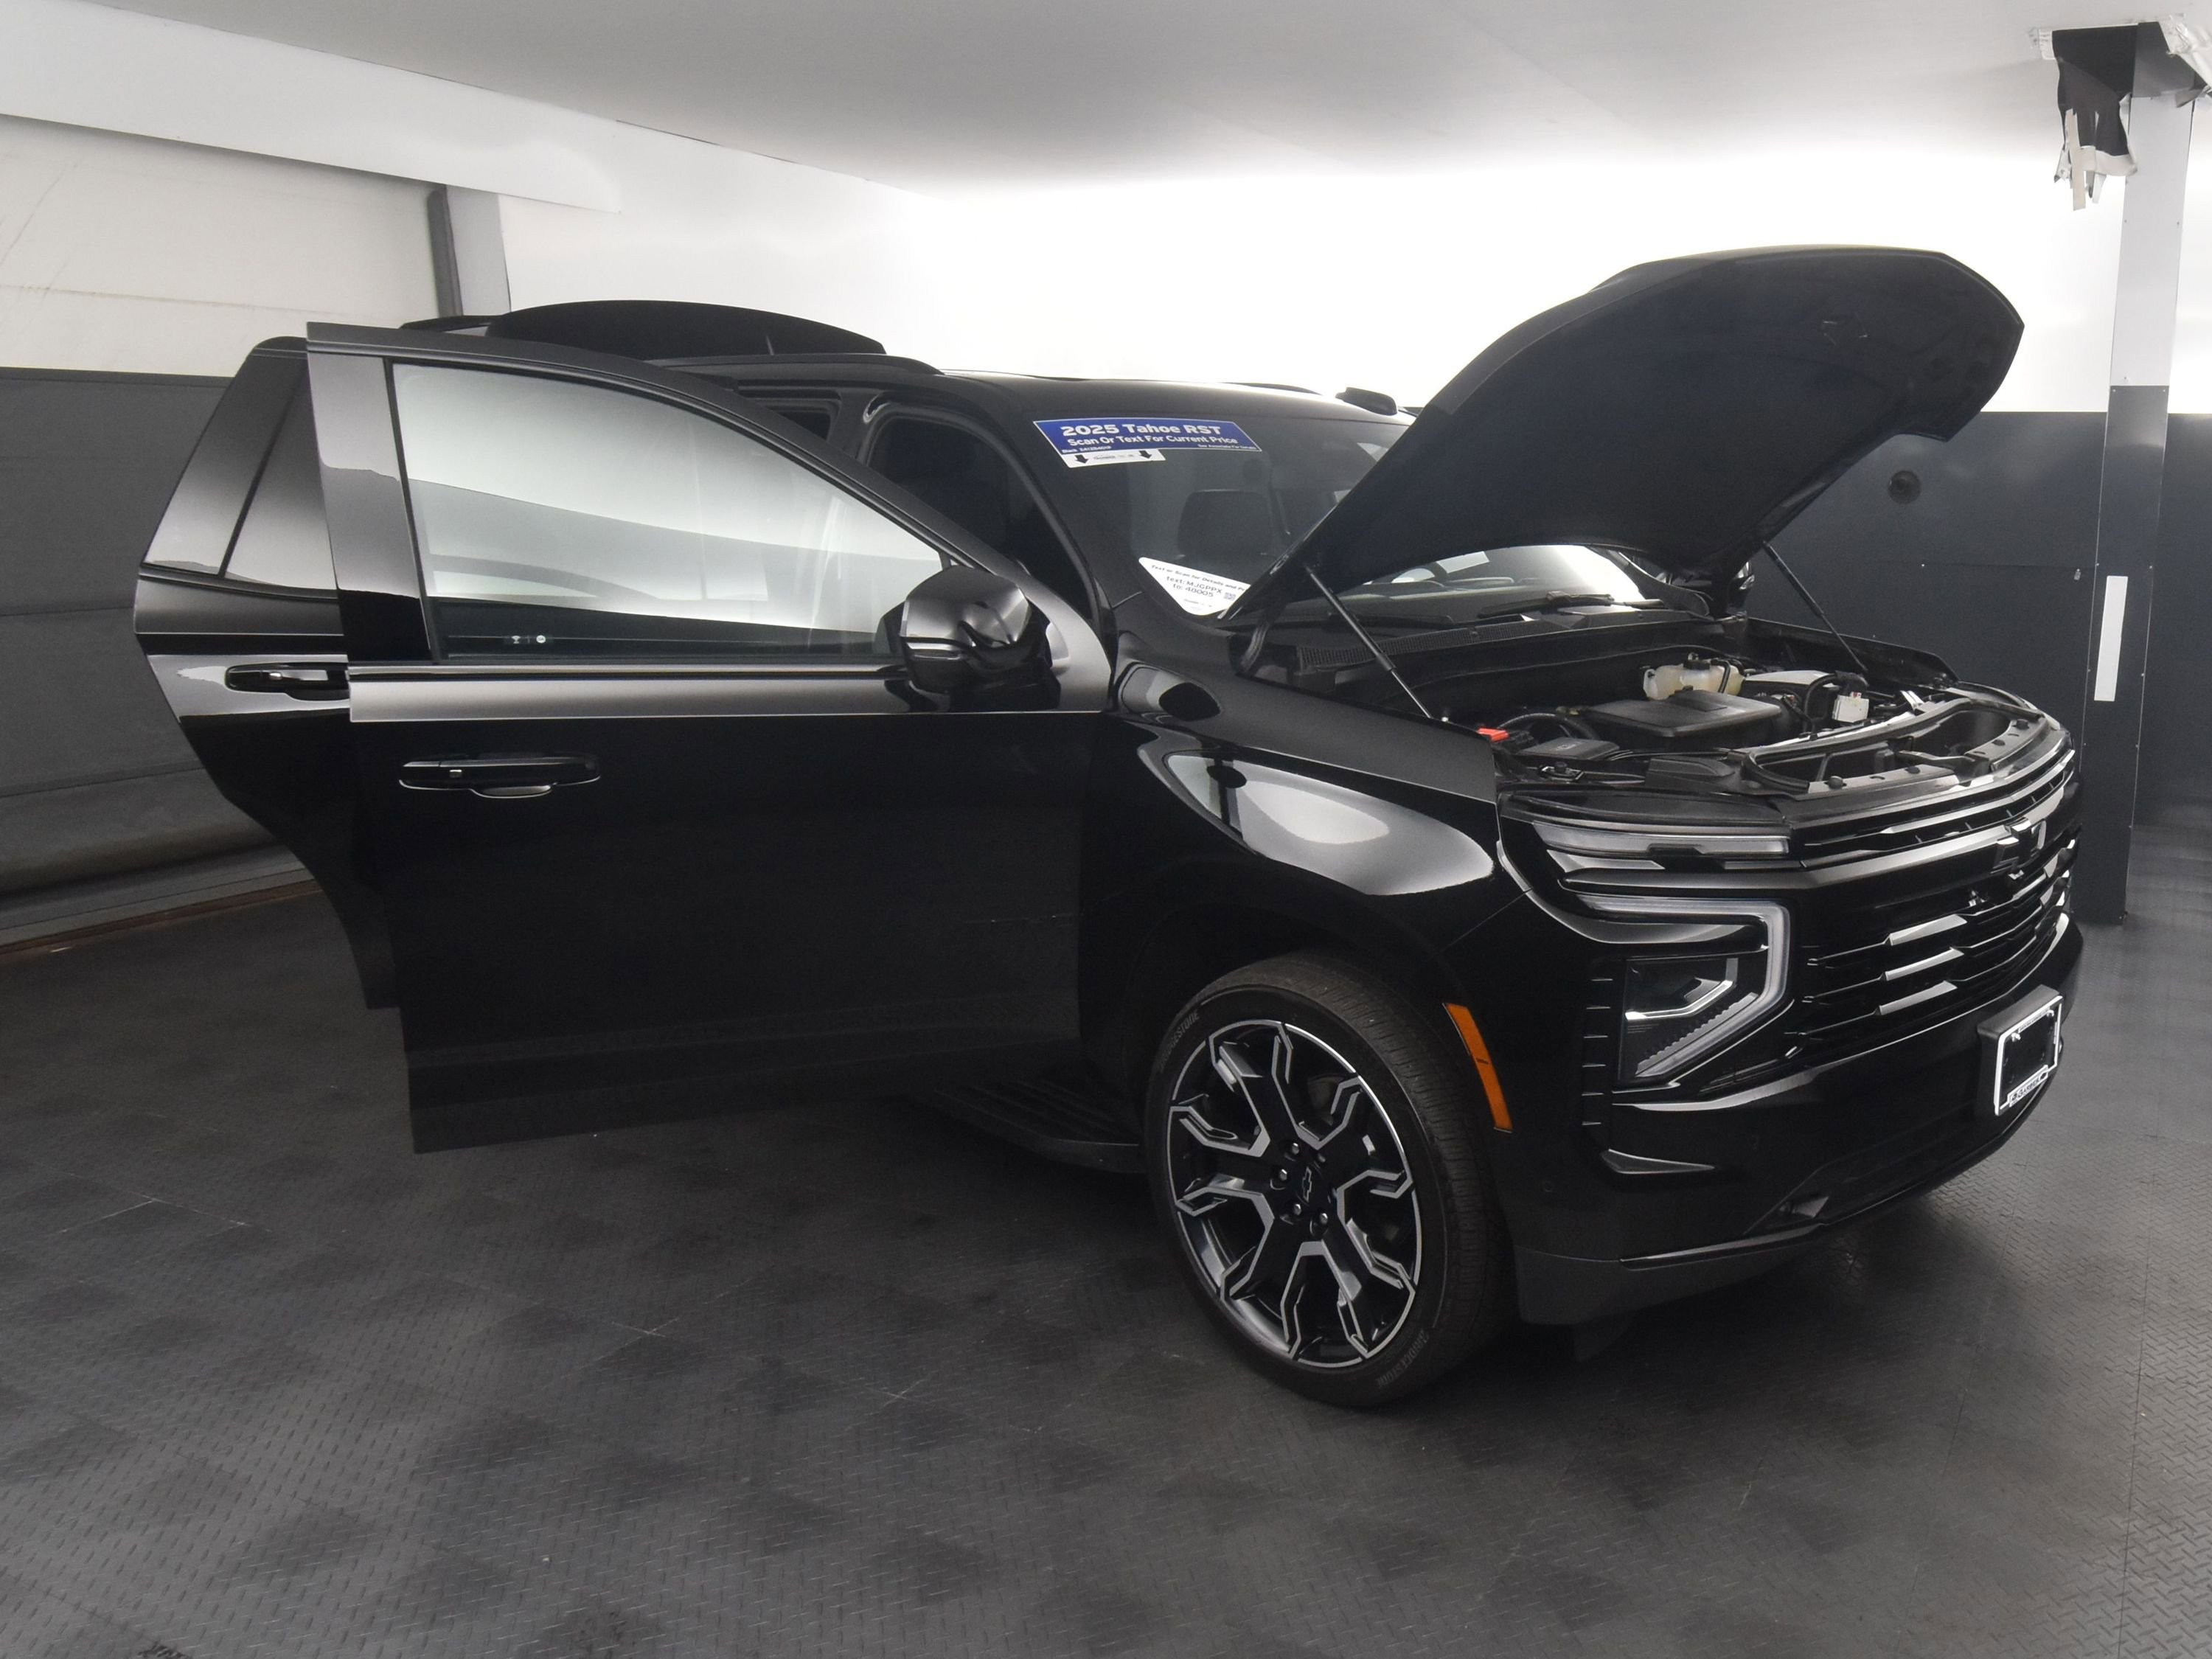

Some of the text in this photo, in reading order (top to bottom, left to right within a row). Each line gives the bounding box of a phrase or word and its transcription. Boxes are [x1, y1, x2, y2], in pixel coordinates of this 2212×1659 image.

[1060, 423, 1221, 437] 2025 Tahoe RST
[1067, 438, 1099, 447] Scan
[1099, 437, 1115, 445] Or
[1166, 435, 1210, 444] Current
[1166, 576, 1222, 594] text: MJGPPX
[1175, 570, 1190, 578] Scan
[1202, 577, 1224, 586] Details
[1185, 586, 1214, 597] 48005
[1156, 1009, 1200, 1074] BRIDGESTONE
